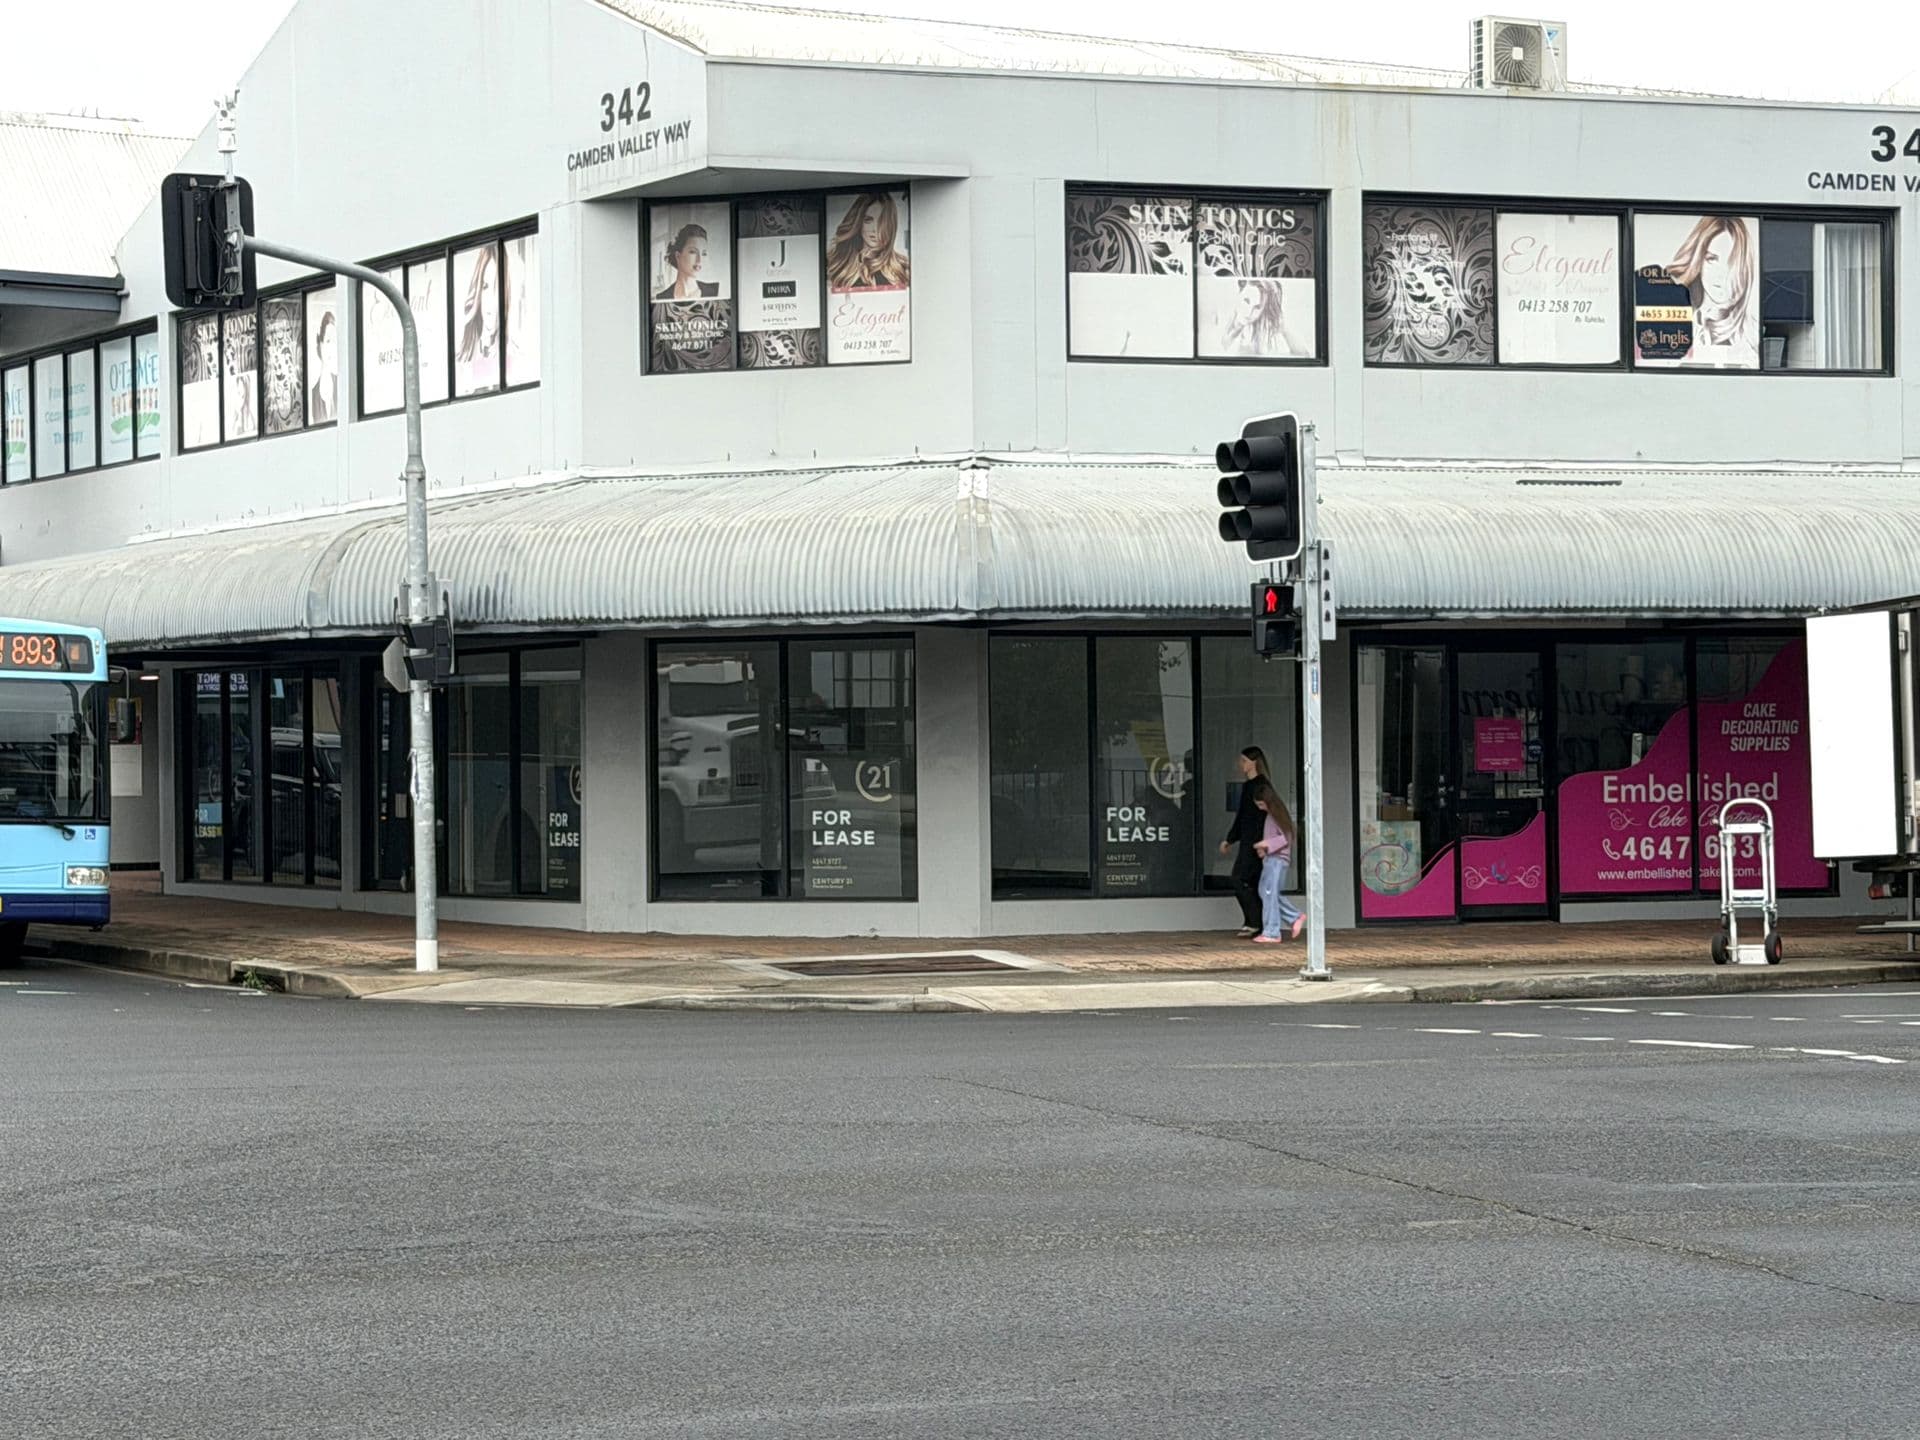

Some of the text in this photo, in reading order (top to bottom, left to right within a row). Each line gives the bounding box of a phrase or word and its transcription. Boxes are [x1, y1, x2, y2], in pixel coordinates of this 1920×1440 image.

[600, 81, 651, 132] 342
[567, 120, 691, 172] CAMDEN VALLEY WAY
[1808, 172, 1896, 192] CAMDEN
[1129, 204, 1296, 230] SKIN TONICS
[1246, 231, 1287, 247] Clinic
[771, 240, 786, 268] J
[1503, 236, 1613, 287] Elegant
[1519, 299, 1592, 313] 0413 258 707
[1640, 309, 1687, 319] 4655 3322
[655, 319, 729, 333] SKIN TONICS
[833, 303, 905, 333] Elegant
[1660, 330, 1689, 349] Inglis
[12, 635, 56, 665] 893
[1743, 703, 1777, 718] CAKE
[1721, 720, 1799, 735] DECORATING
[1730, 737, 1790, 752] SUPPLIES
[1603, 773, 1778, 804] Embellished
[549, 812, 569, 828] FOR
[812, 810, 851, 826] FOR
[1106, 806, 1146, 823] FOR
[1649, 805, 1687, 829] Cake
[549, 832, 580, 848] LEASE
[812, 829, 876, 846] LEASE
[1106, 826, 1170, 842] LEASE
[1622, 835, 1768, 861] 4647 63
